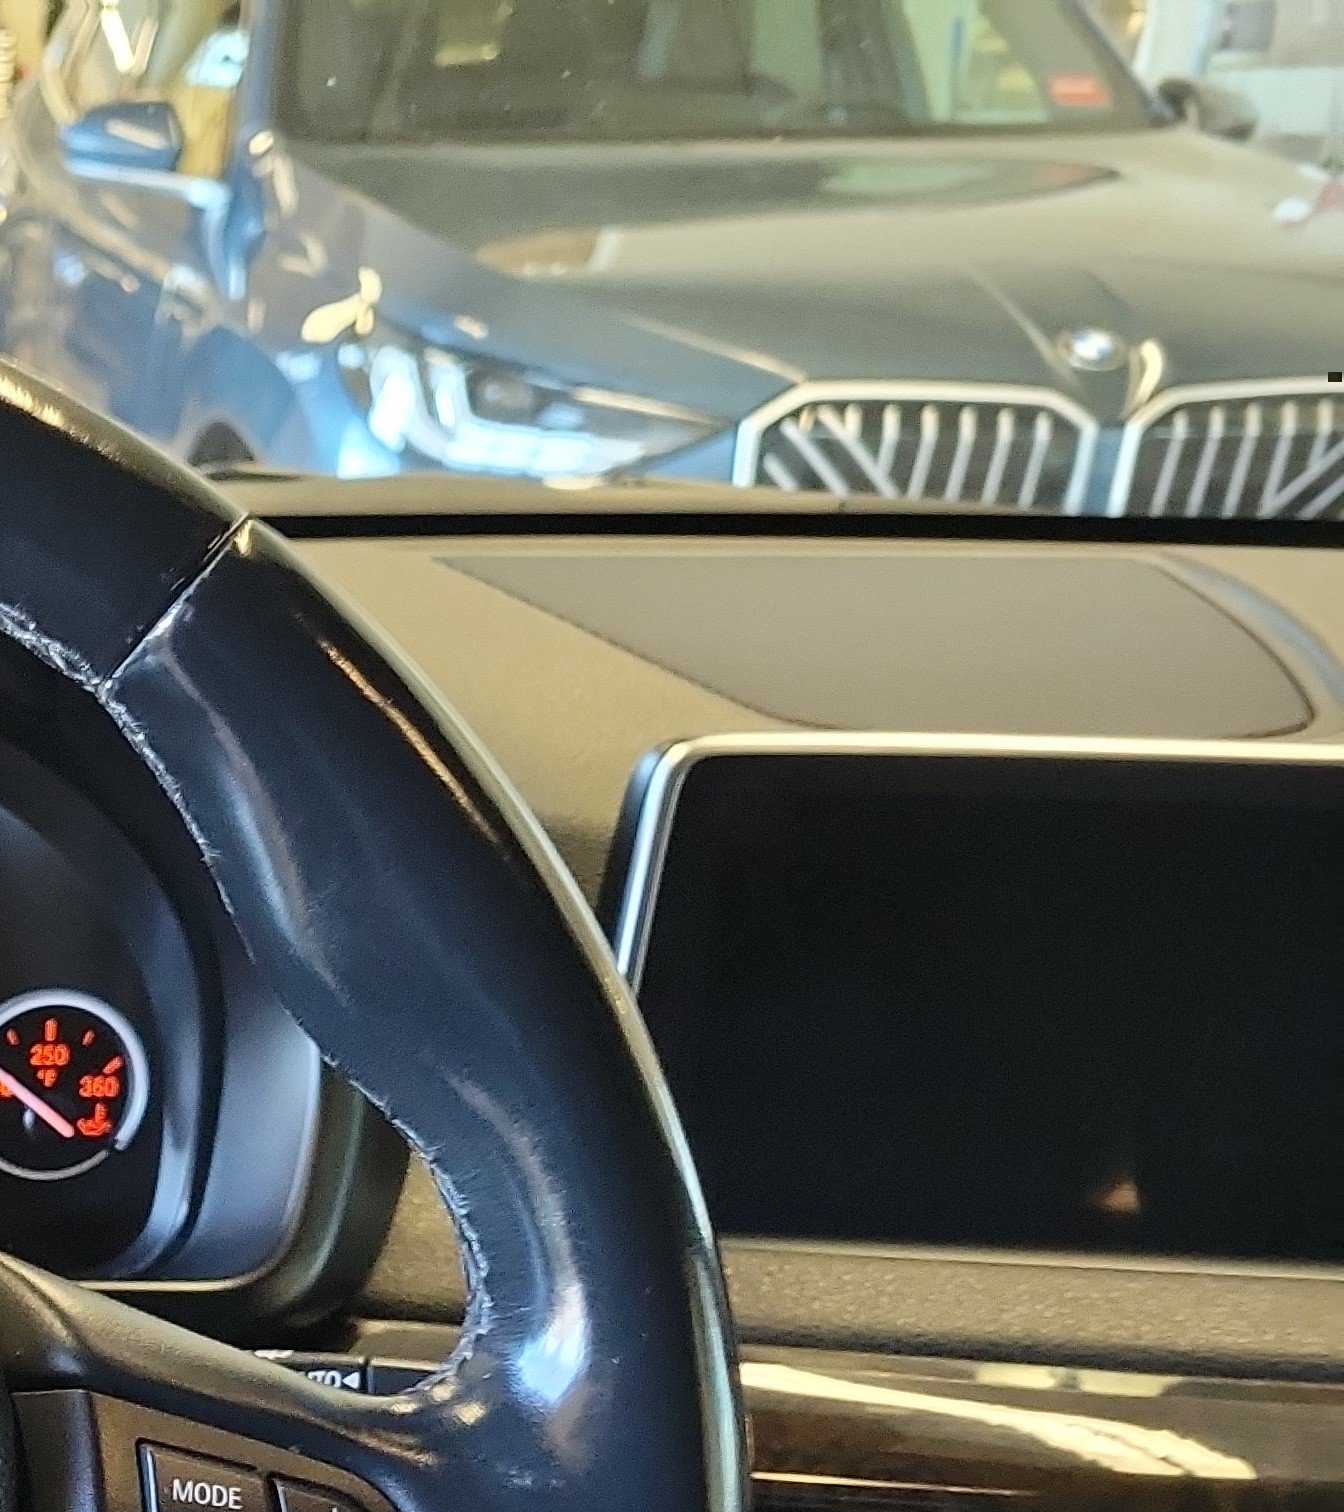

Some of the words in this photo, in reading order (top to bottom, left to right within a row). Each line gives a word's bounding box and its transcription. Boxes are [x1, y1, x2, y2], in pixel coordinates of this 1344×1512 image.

[30, 1043, 70, 1066] 250
[79, 1074, 120, 1097] 360
[172, 1478, 244, 1510] MODE
